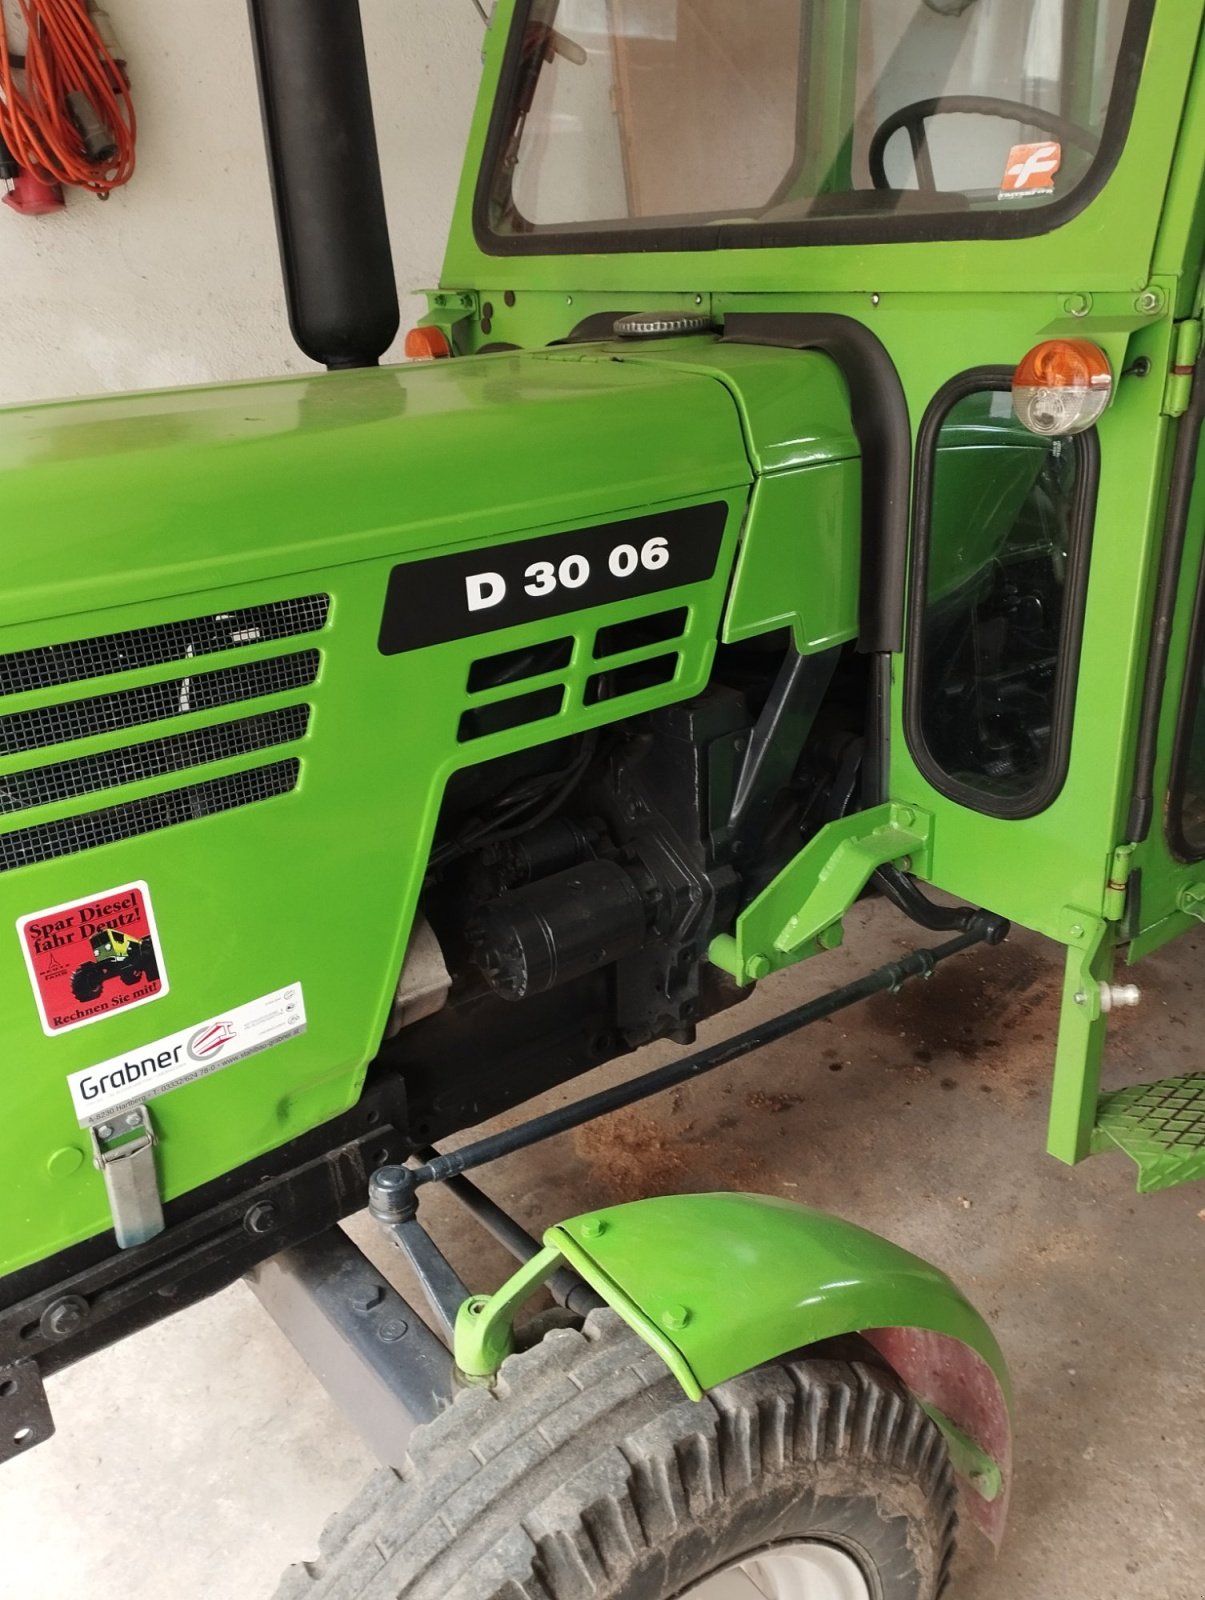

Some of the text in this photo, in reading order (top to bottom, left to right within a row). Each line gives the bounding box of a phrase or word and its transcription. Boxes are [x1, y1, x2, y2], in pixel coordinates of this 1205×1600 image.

[465, 536, 670, 612] D 30 06
[29, 892, 138, 940] Spar Diesel
[33, 907, 141, 954] fahr Deutz!
[52, 982, 158, 1027] Rechnen Sie mit!
[79, 1044, 183, 1100] Grabner
